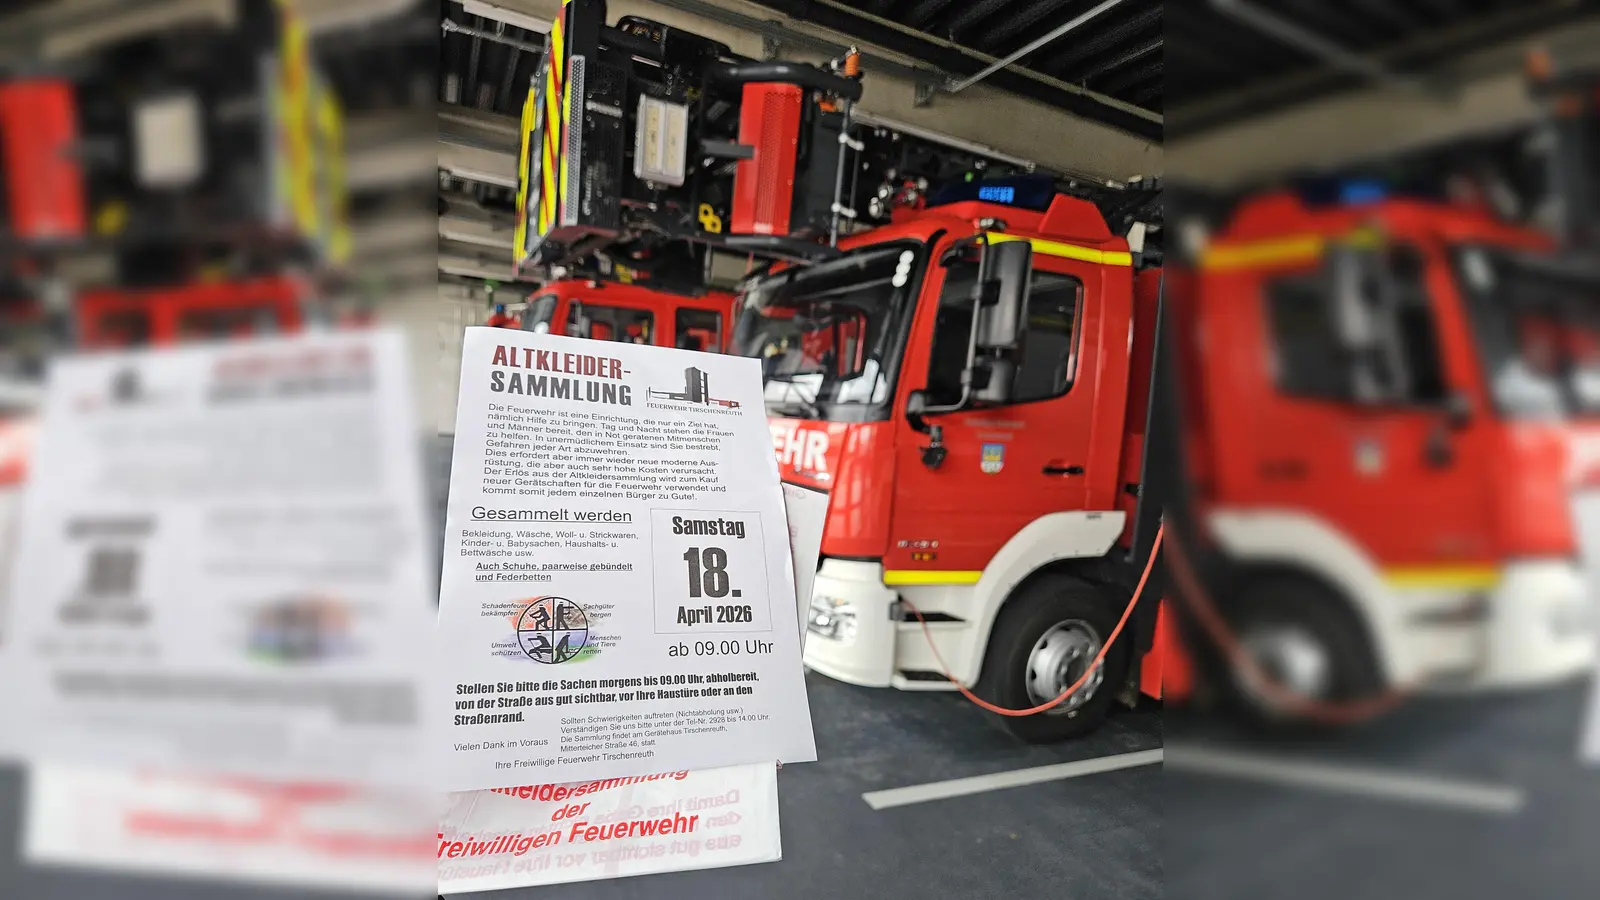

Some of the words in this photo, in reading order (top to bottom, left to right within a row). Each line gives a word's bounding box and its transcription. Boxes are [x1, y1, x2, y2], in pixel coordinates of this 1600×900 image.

[492, 345, 631, 379] ALTKLEIDER-
[490, 371, 631, 405] SAMMLUNG
[488, 403, 504, 411] Die
[507, 405, 555, 415] Feuerwehr
[647, 403, 688, 412] FEUERWEHR
[689, 407, 742, 416] TIRSCHENREUTH
[485, 448, 506, 456] Dies
[510, 451, 549, 459] erfordert
[486, 439, 530, 449] Gefahren
[532, 443, 555, 451] jeder
[574, 446, 629, 455] abzuwehren.
[504, 468, 529, 476] Erlös
[569, 471, 656, 483] Altkleidersammlung
[514, 478, 581, 487] Gerätschaften
[548, 488, 576, 497] jedem
[626, 491, 654, 500] Bürger
[472, 506, 568, 520] Gesammelt
[574, 510, 632, 522] werden
[589, 531, 638, 539] Strickwaren,
[672, 516, 745, 538] Samstag
[542, 563, 587, 572] paarweise
[590, 563, 633, 572] gebündelt
[684, 547, 741, 598] 18.
[677, 606, 712, 626] April
[716, 606, 752, 623] 2026
[668, 642, 689, 656] ab
[695, 641, 739, 655] 09.00
[746, 640, 773, 654] Uhr
[456, 683, 494, 694] Stellen
[496, 682, 513, 692] Sie
[516, 681, 539, 691] bitte
[542, 680, 557, 690] die
[560, 679, 596, 690] Sachen
[599, 678, 641, 688] morgens
[644, 676, 657, 686] bis
[660, 674, 685, 685] 09.00
[687, 674, 704, 684] Uhr,
[706, 671, 759, 682] abholbereit,
[455, 700, 474, 709] von
[477, 698, 494, 708] der
[497, 696, 532, 707] Straße
[535, 696, 553, 705] aus
[556, 694, 572, 706] gut
[574, 692, 616, 703] sichtbar,
[618, 692, 633, 701] vor
[636, 690, 655, 700] Ihre
[657, 688, 698, 699] Haustüre
[700, 687, 720, 696] oder
[736, 685, 752, 695] den
[454, 712, 524, 725] Straßenrand.
[588, 714, 642, 723] Schwierigkeiten
[676, 708, 724, 719] (Nichtabholung
[726, 707, 743, 717] usw.)
[560, 724, 607, 733] Verständigen
[574, 732, 610, 743] Sammlung
[612, 732, 630, 740] findet
[644, 728, 684, 737] Gerätehaus
[683, 725, 727, 734] Tirschenreuth,
[454, 742, 480, 751] Vielen
[482, 740, 504, 749] Dank
[519, 739, 548, 747] Voraus
[560, 743, 602, 752] Mitterteicher
[604, 740, 627, 749] Straße
[514, 758, 554, 767] Freiwillige
[557, 754, 600, 764] Feuerwehr
[602, 749, 654, 760] Tirschenreuth
[552, 802, 590, 821] der
[437, 831, 562, 858] reiwilligen
[568, 812, 699, 842] Feuerwehr
